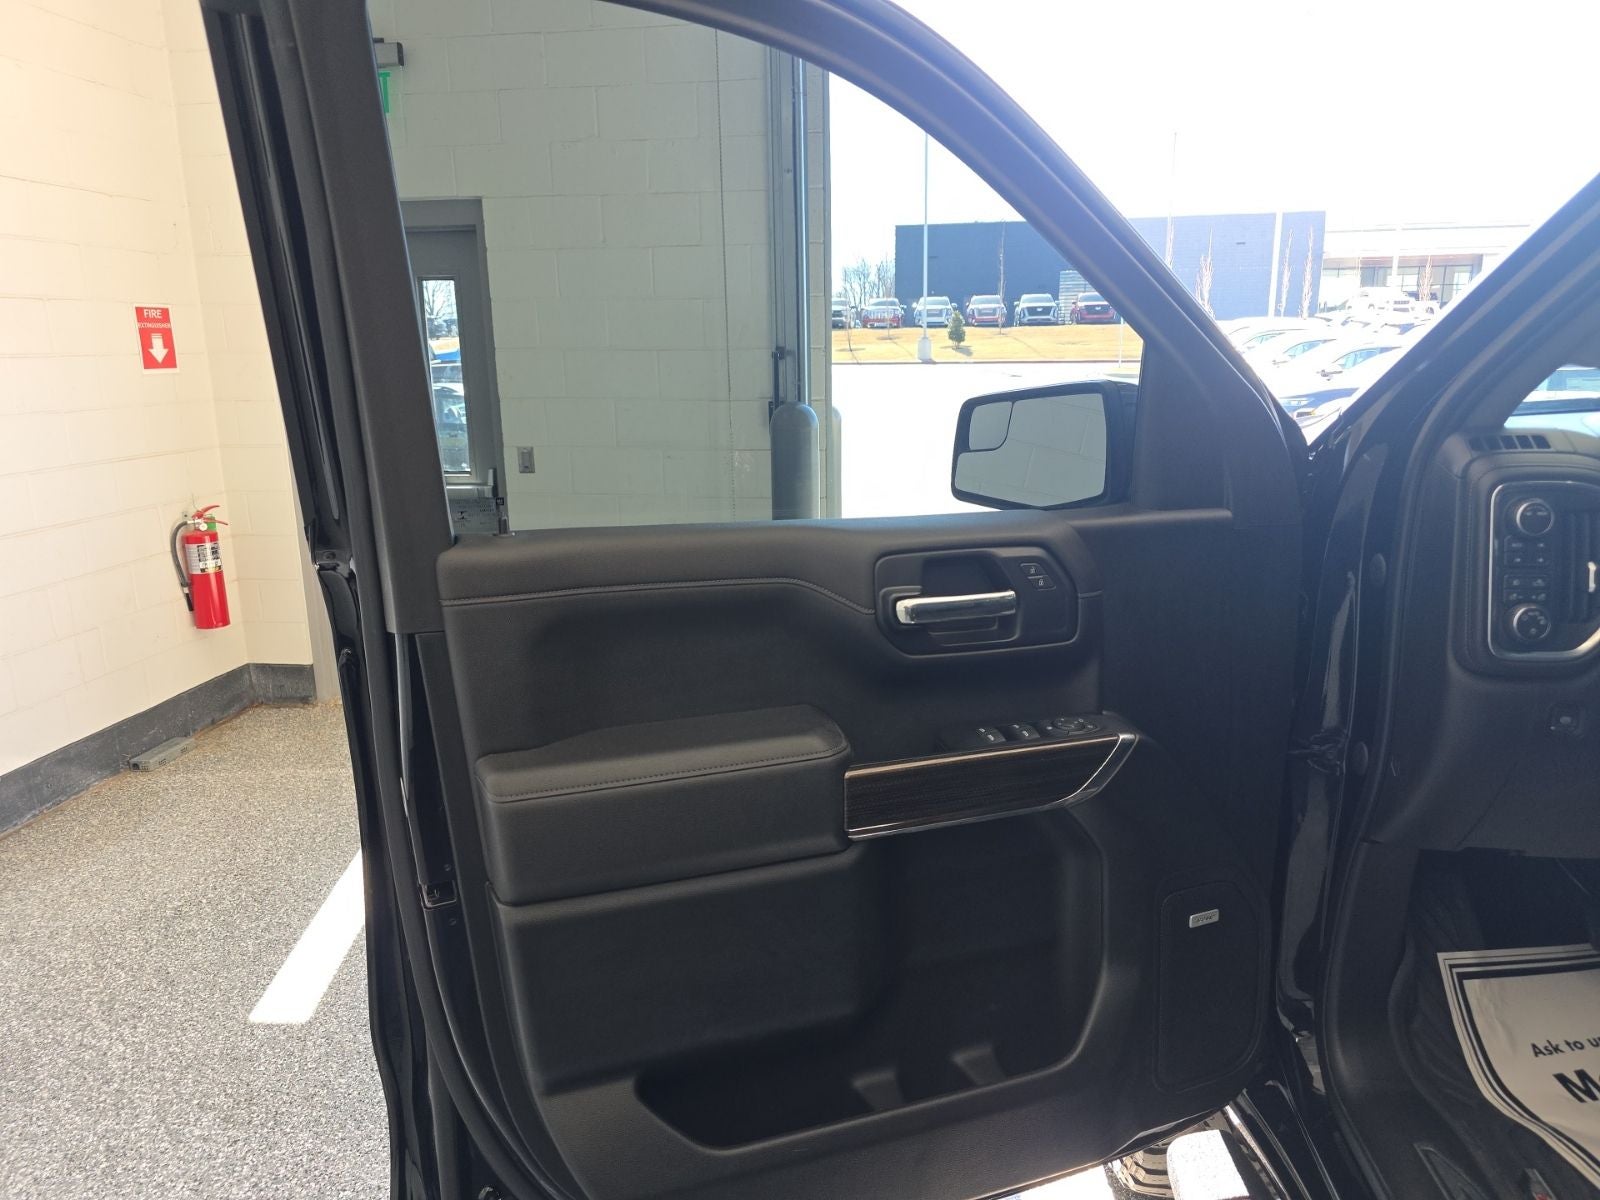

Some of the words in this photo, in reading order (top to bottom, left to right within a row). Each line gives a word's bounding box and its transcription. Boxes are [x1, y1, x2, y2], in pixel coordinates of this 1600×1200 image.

[143, 309, 163, 319] FIRE
[1531, 1039, 1565, 1057] Ask
[1563, 1039, 1585, 1051] to
[1552, 1068, 1600, 1103] M
